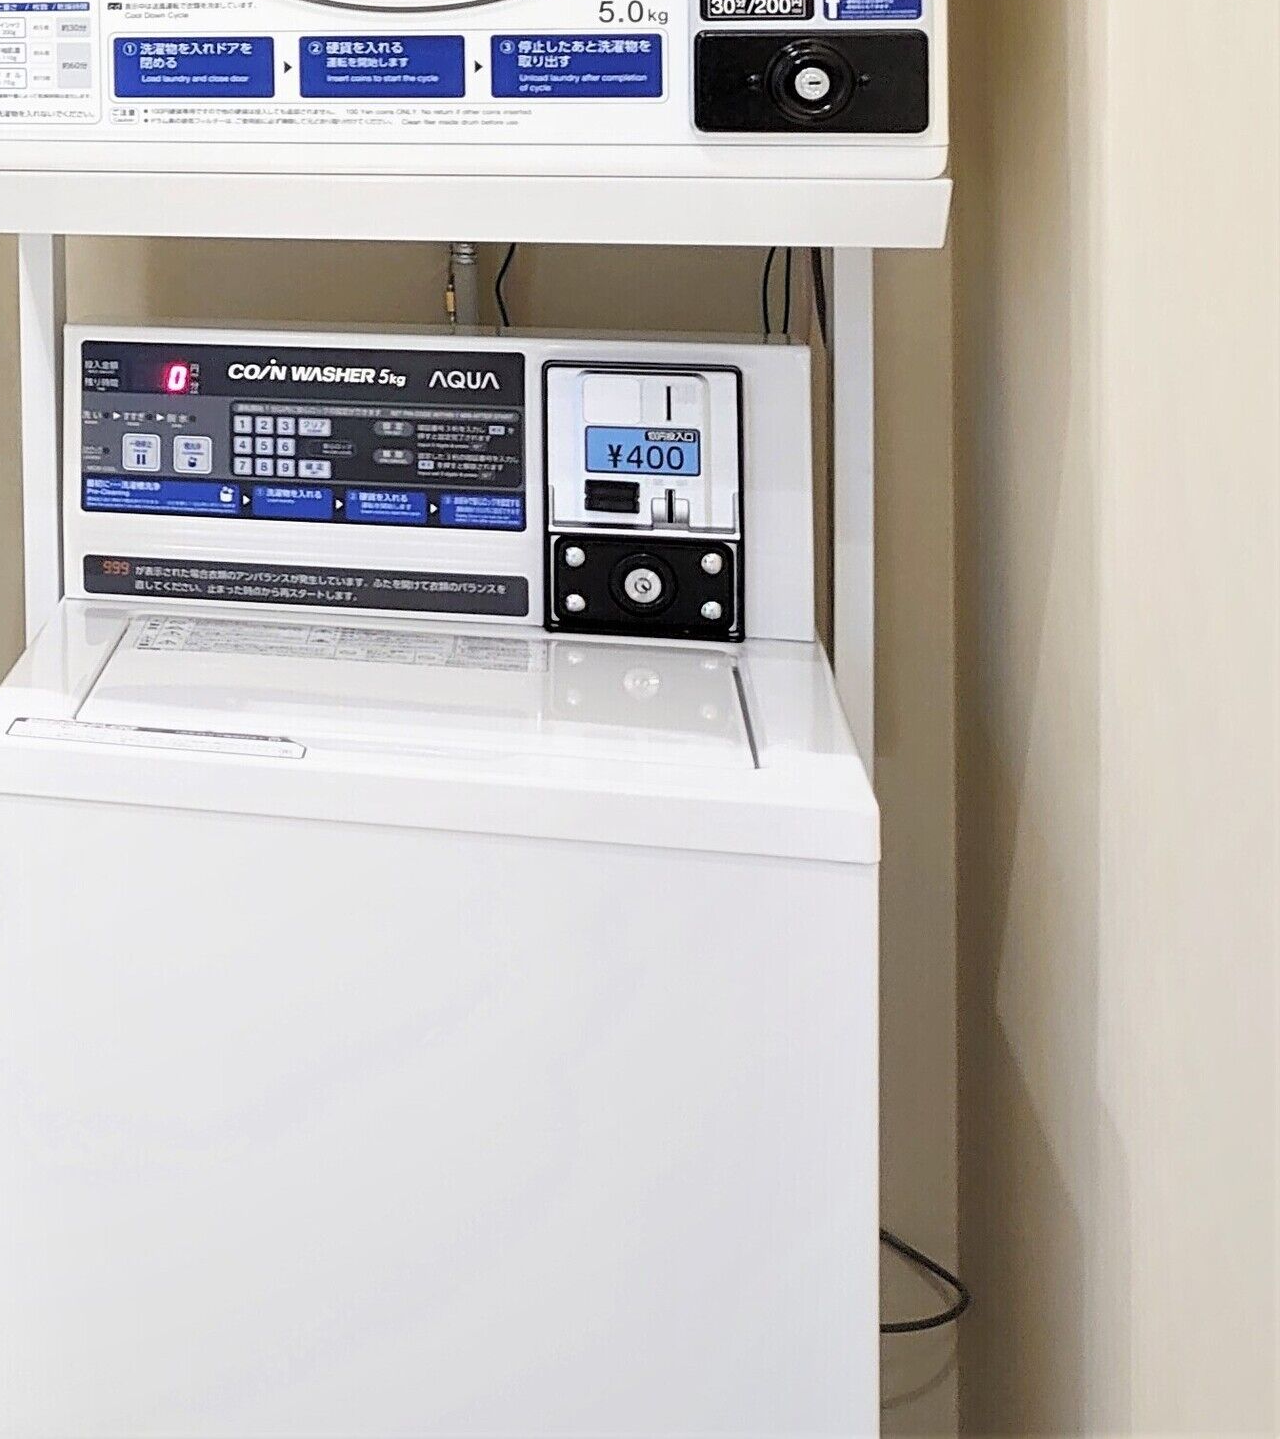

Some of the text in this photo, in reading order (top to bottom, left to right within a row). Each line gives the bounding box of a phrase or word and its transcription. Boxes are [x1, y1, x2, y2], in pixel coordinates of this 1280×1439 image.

[599, 0, 668, 24] 5.0 kg
[167, 366, 187, 390] 0
[228, 359, 287, 381] COIN
[291, 365, 375, 384] WASHER
[429, 371, 500, 389] AQUA
[608, 444, 685, 470] ¥400
[102, 561, 130, 575] 999
